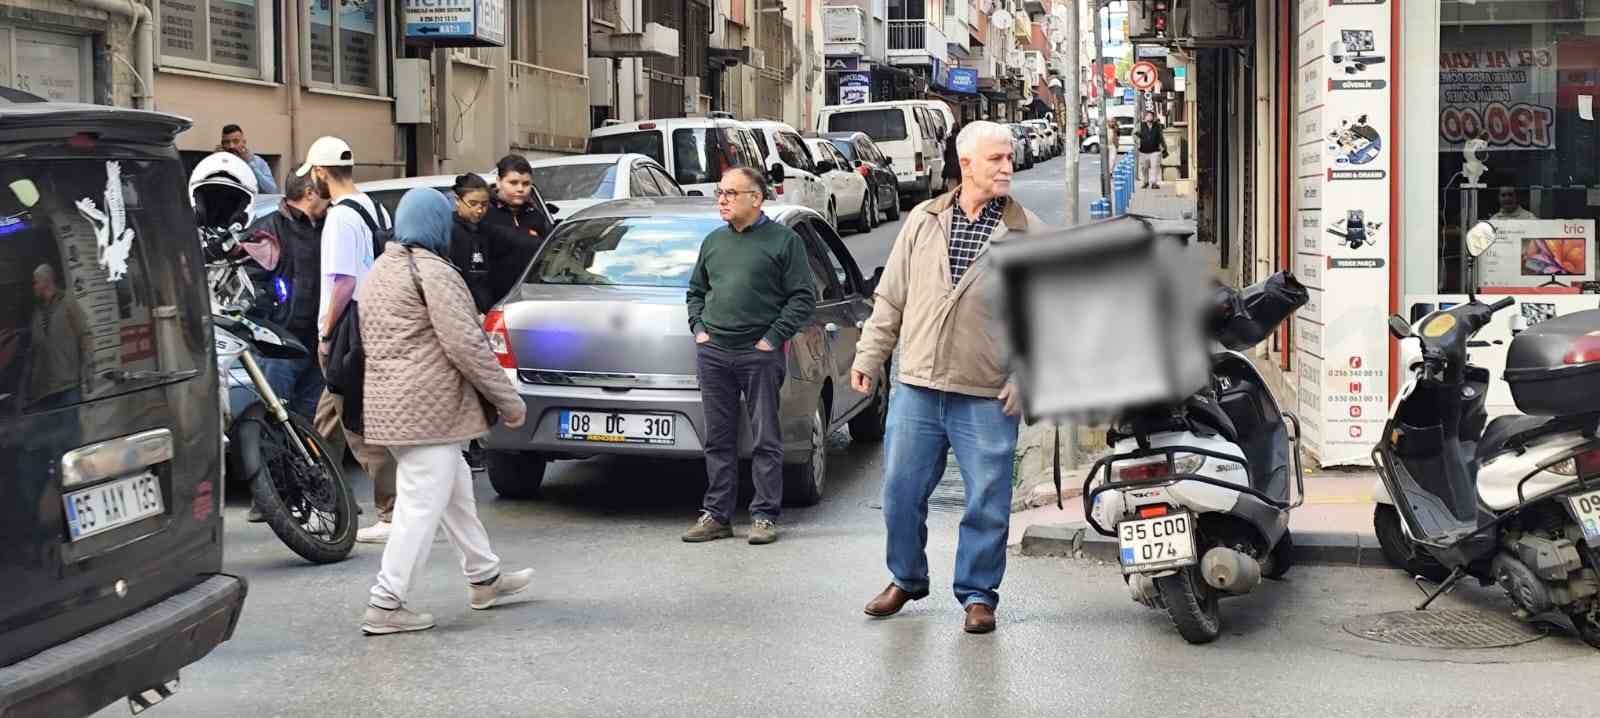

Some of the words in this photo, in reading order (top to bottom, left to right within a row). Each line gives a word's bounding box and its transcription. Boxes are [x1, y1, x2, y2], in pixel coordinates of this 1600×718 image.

[1564, 223, 1585, 234] trio
[571, 414, 590, 433] 08
[606, 415, 625, 434] DC
[644, 418, 670, 437] 310
[1123, 523, 1146, 541] 35
[1142, 541, 1177, 560] 074
